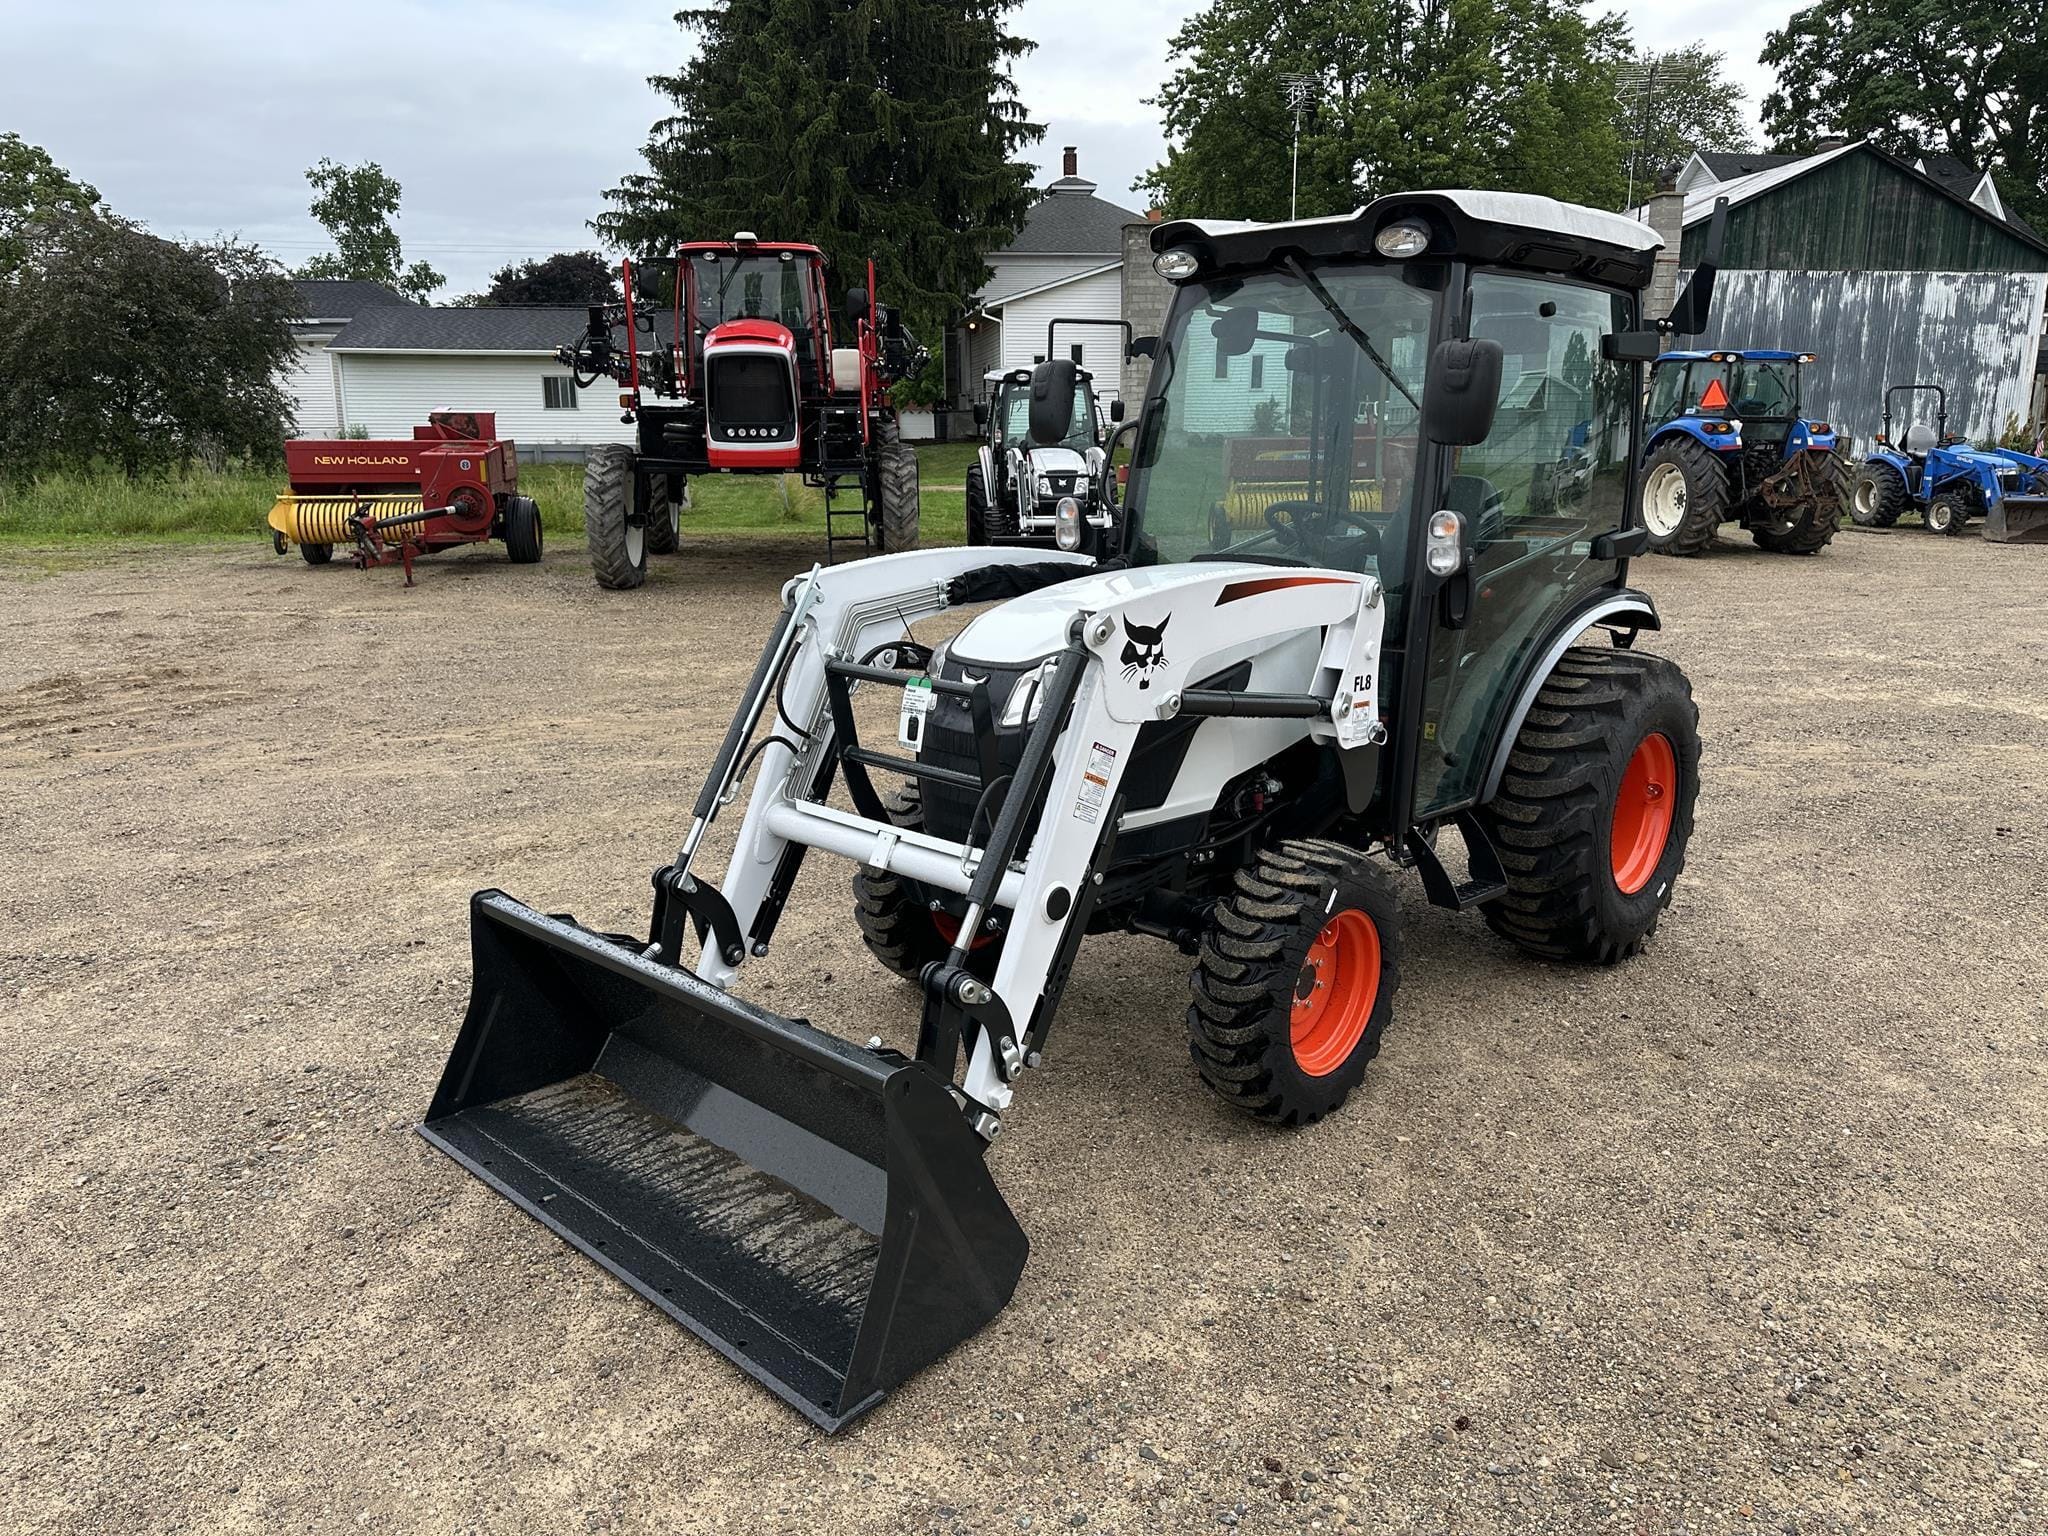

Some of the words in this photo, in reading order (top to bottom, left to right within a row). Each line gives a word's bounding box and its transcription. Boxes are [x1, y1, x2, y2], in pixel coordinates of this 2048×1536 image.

[315, 456, 344, 465] NEW
[348, 456, 409, 465] HOLLAND
[1354, 675, 1371, 692] FL8
